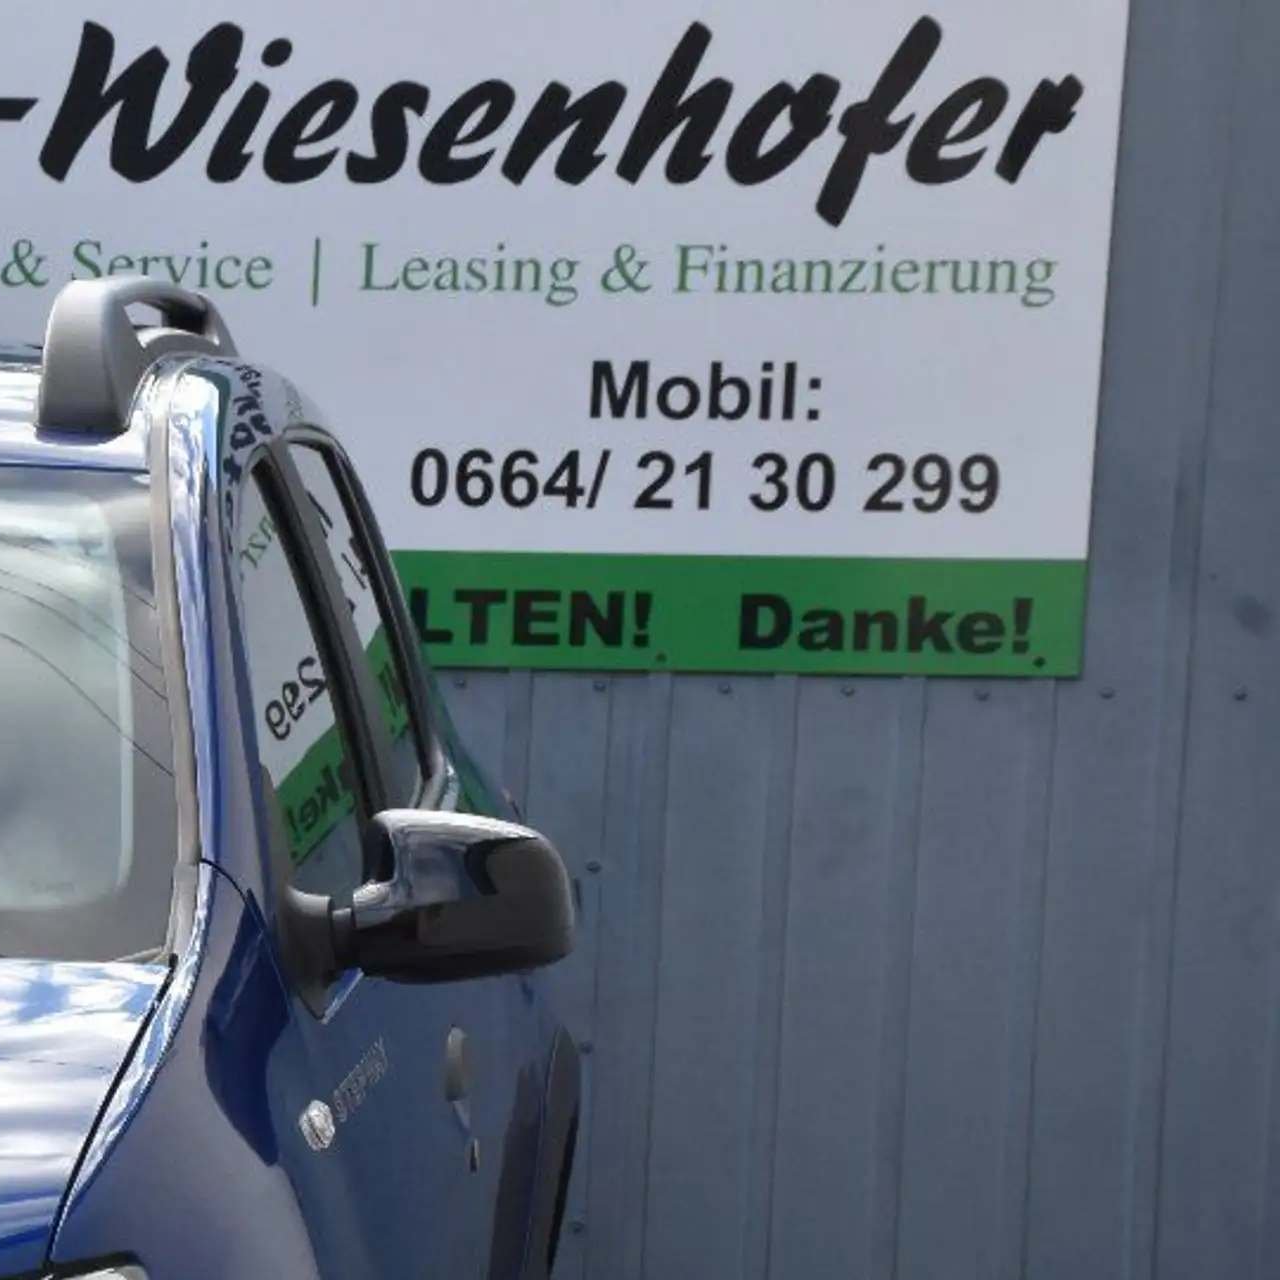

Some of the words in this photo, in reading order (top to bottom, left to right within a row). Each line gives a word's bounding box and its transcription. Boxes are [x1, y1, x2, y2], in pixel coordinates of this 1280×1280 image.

[0, 237, 50, 288] &
[72, 239, 274, 290] Service
[359, 242, 580, 307] Leasing
[599, 244, 652, 295] &
[674, 244, 1059, 308] Finanzierung
[589, 360, 822, 421] Mobil:
[410, 447, 611, 509] 0664/
[634, 450, 714, 510] 21
[748, 452, 836, 512] 30
[862, 453, 1000, 513] 299
[738, 591, 1034, 655] Danke!
